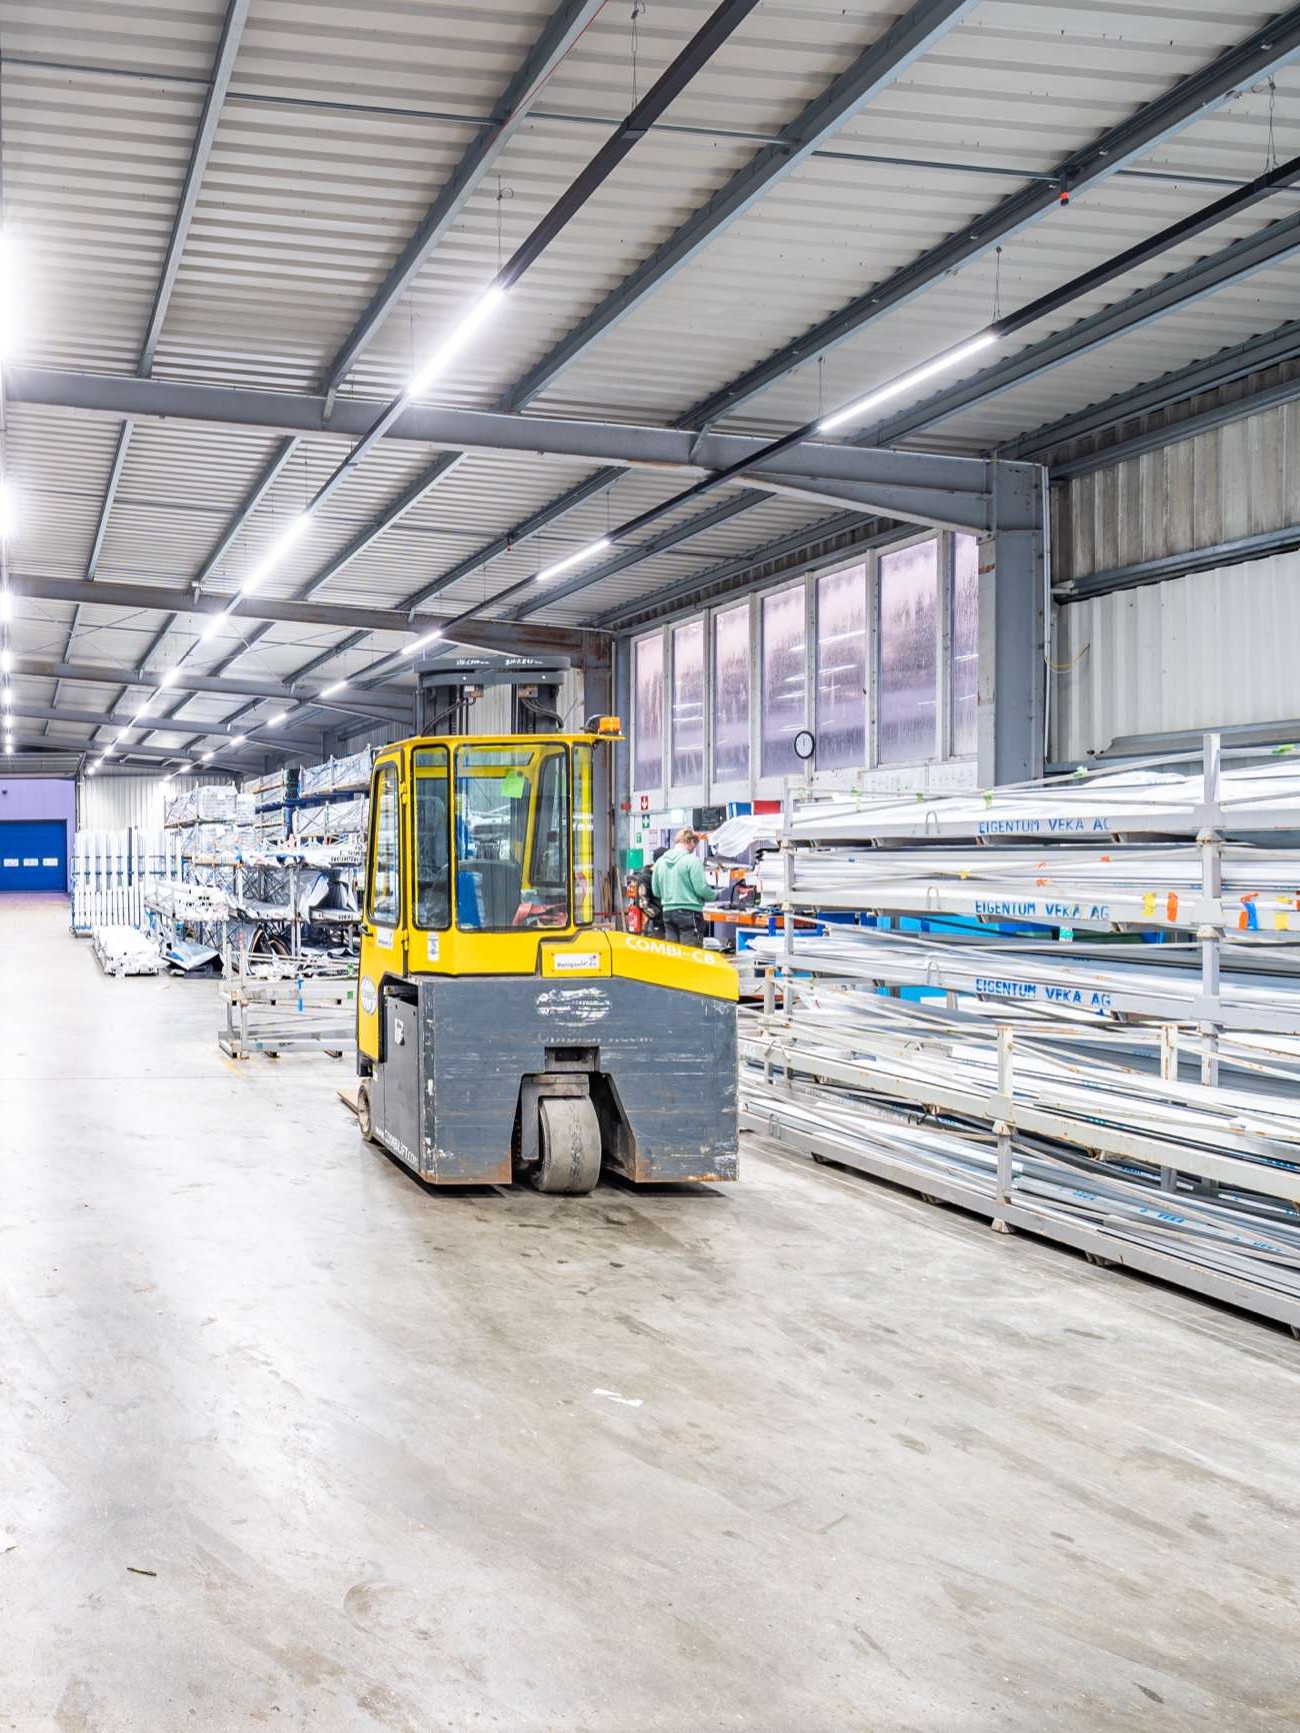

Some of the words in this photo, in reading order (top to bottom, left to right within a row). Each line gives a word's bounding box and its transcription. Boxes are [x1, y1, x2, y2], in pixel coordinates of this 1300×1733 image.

[978, 818, 1040, 834] EIGENTUM
[1048, 817, 1084, 831] VEKA
[975, 900, 1037, 916] EIGENTUM
[1045, 903, 1081, 918] VEKA
[1090, 905, 1110, 920] AG
[975, 978, 1037, 998] EIGENTUM
[1046, 986, 1082, 1005] VEKA
[1091, 991, 1111, 1007] AG
